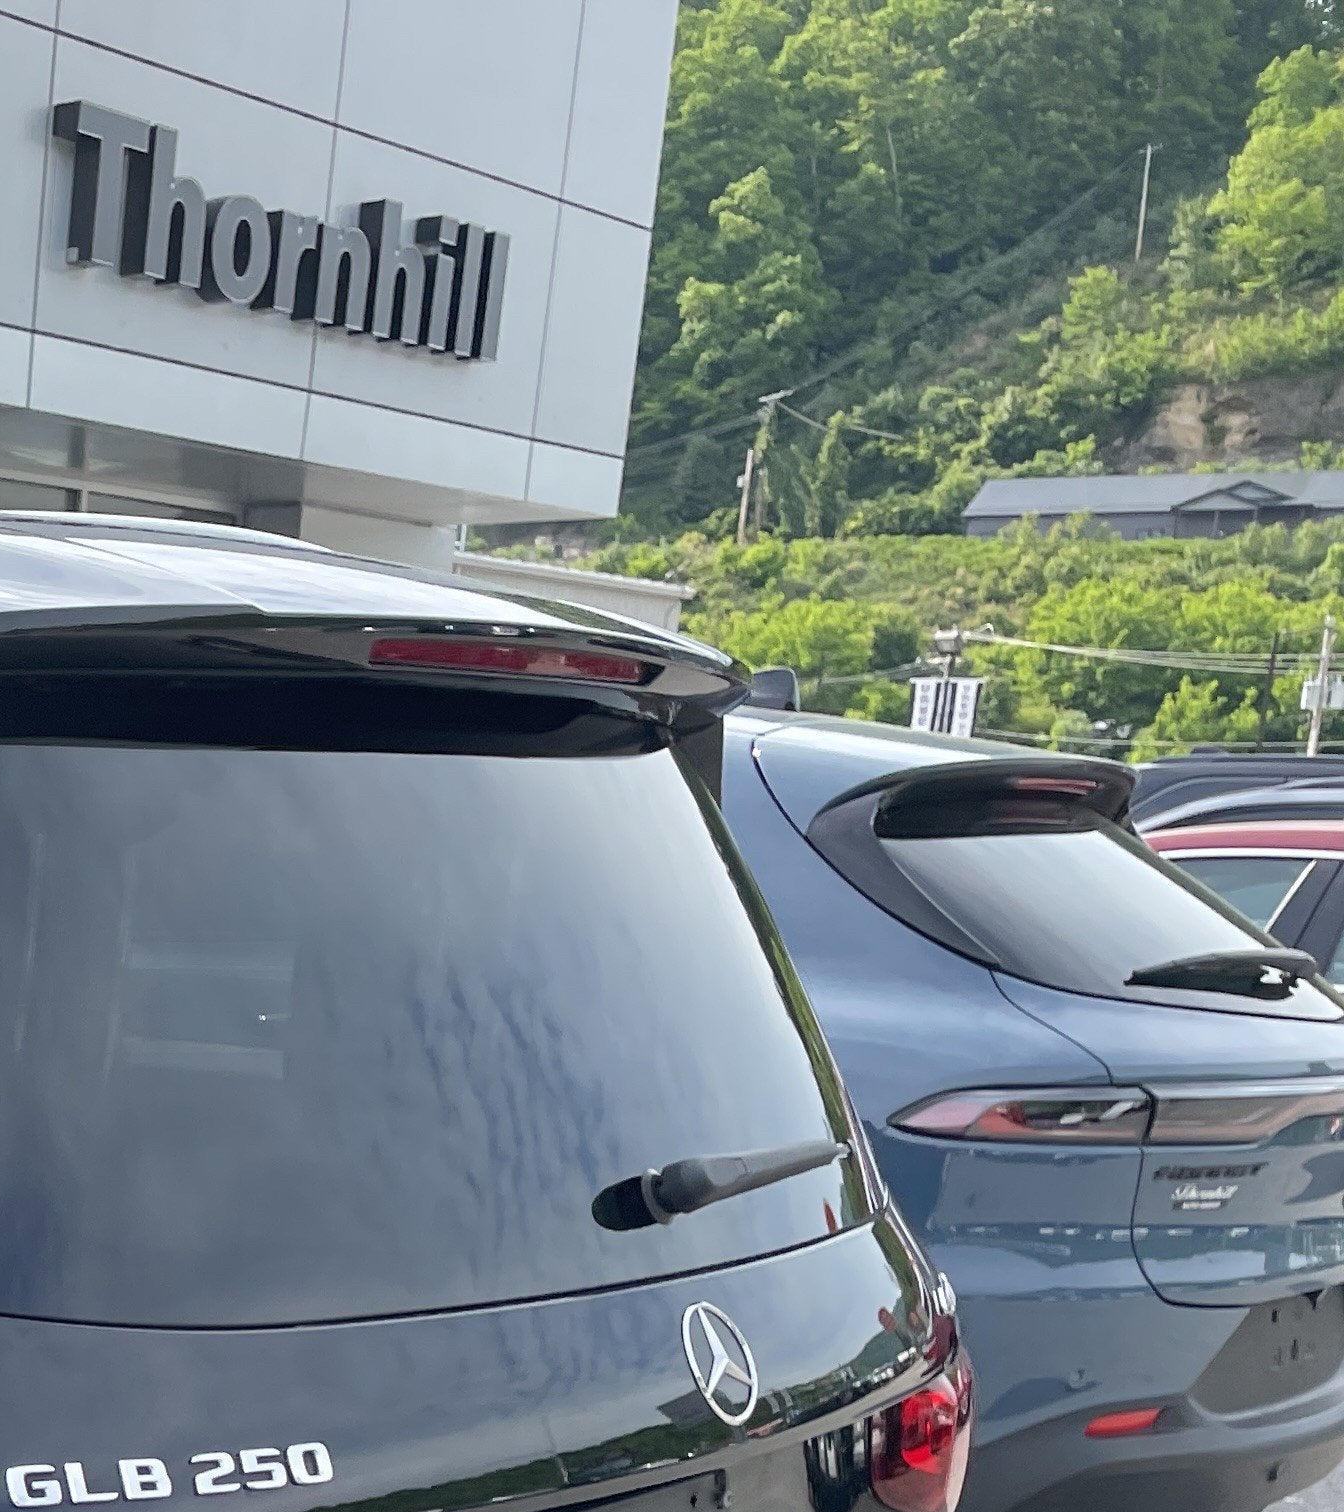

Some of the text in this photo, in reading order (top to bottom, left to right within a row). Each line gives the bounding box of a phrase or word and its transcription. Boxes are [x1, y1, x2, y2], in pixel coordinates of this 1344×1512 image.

[52, 100, 510, 361] Thornhill
[5, 1441, 334, 1508] GLB 250
